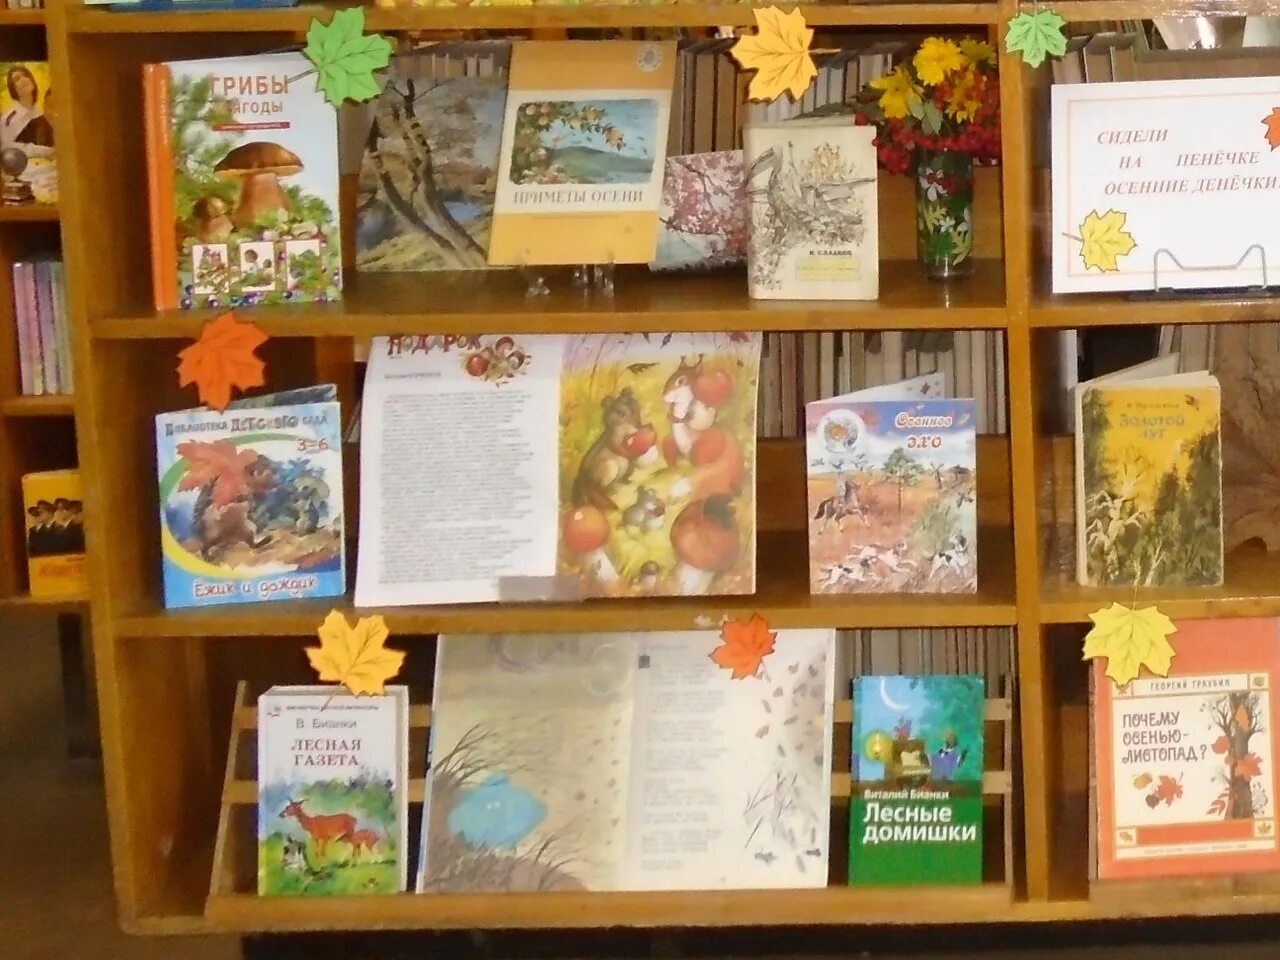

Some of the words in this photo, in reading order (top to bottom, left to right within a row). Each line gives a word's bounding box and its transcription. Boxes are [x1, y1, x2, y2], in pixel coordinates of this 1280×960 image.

[210, 75, 289, 96] ГРИБЫ
[1097, 129, 1168, 145] СИДЕЛИ
[1119, 155, 1142, 169] НА
[1176, 150, 1260, 167] ПЕНЁЧКЕ
[1104, 179, 1188, 196] ОСЕННИЕ
[513, 191, 586, 204] ПРИМЕТЫ
[591, 190, 643, 202] ОСЕНИ
[1123, 711, 1180, 728] ПОЧЕМУ
[291, 740, 361, 751] ЛЕСНАЯ
[295, 755, 358, 766] ГАЗЕТА
[864, 789, 908, 799] Виталий
[910, 789, 949, 799] Бианки
[863, 802, 952, 822] Лесные
[863, 825, 977, 844] домишки
